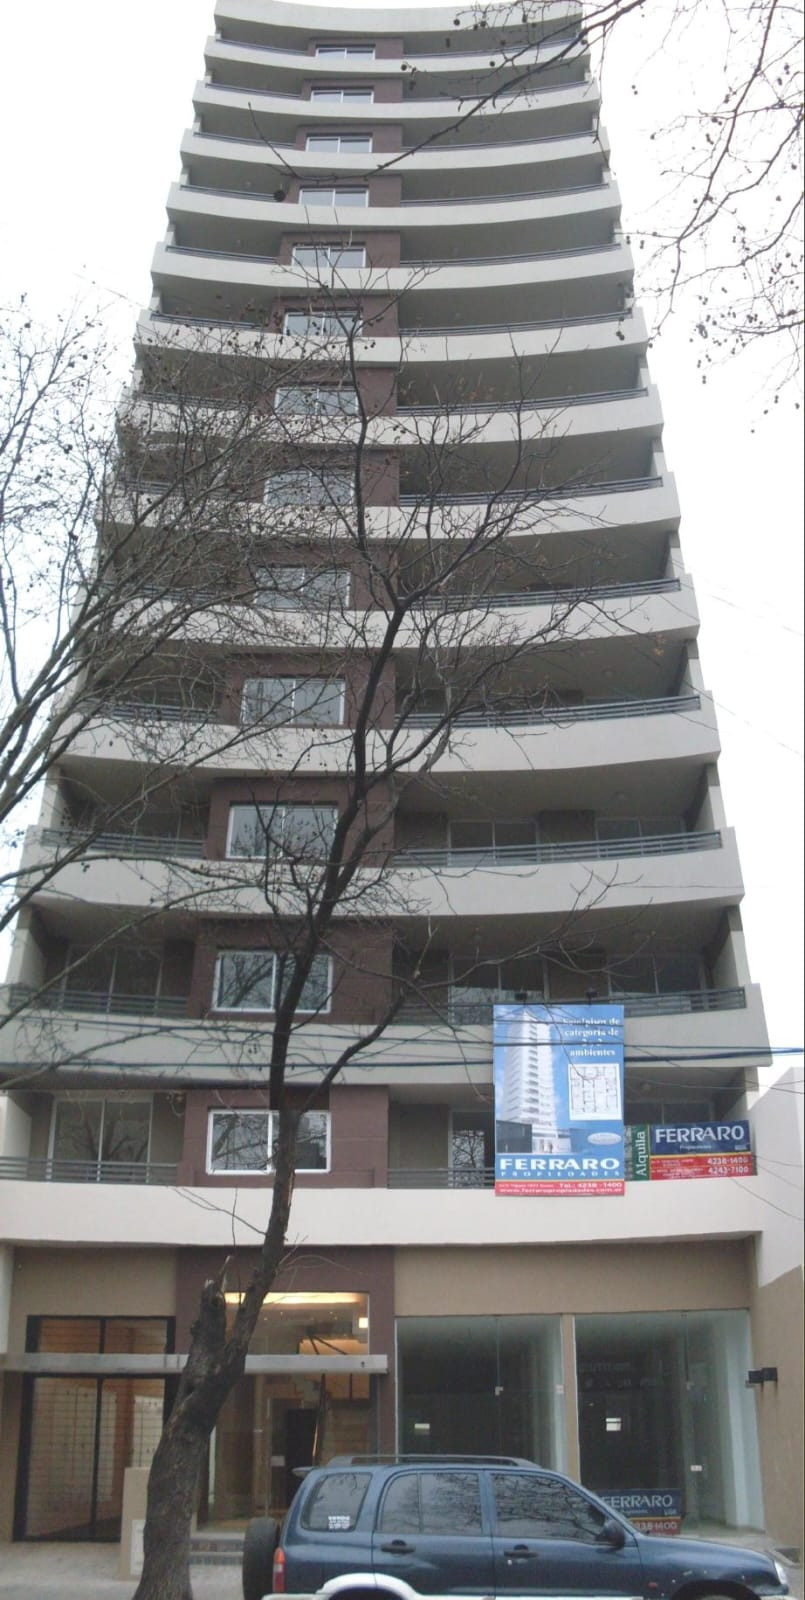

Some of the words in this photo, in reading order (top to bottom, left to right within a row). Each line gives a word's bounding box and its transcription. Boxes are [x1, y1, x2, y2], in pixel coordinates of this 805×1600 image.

[655, 1125, 745, 1143] FERRARO
[635, 1130, 649, 1177] Alquila
[499, 1157, 620, 1170] FERRARO
[603, 1494, 673, 1508] FERRARO
